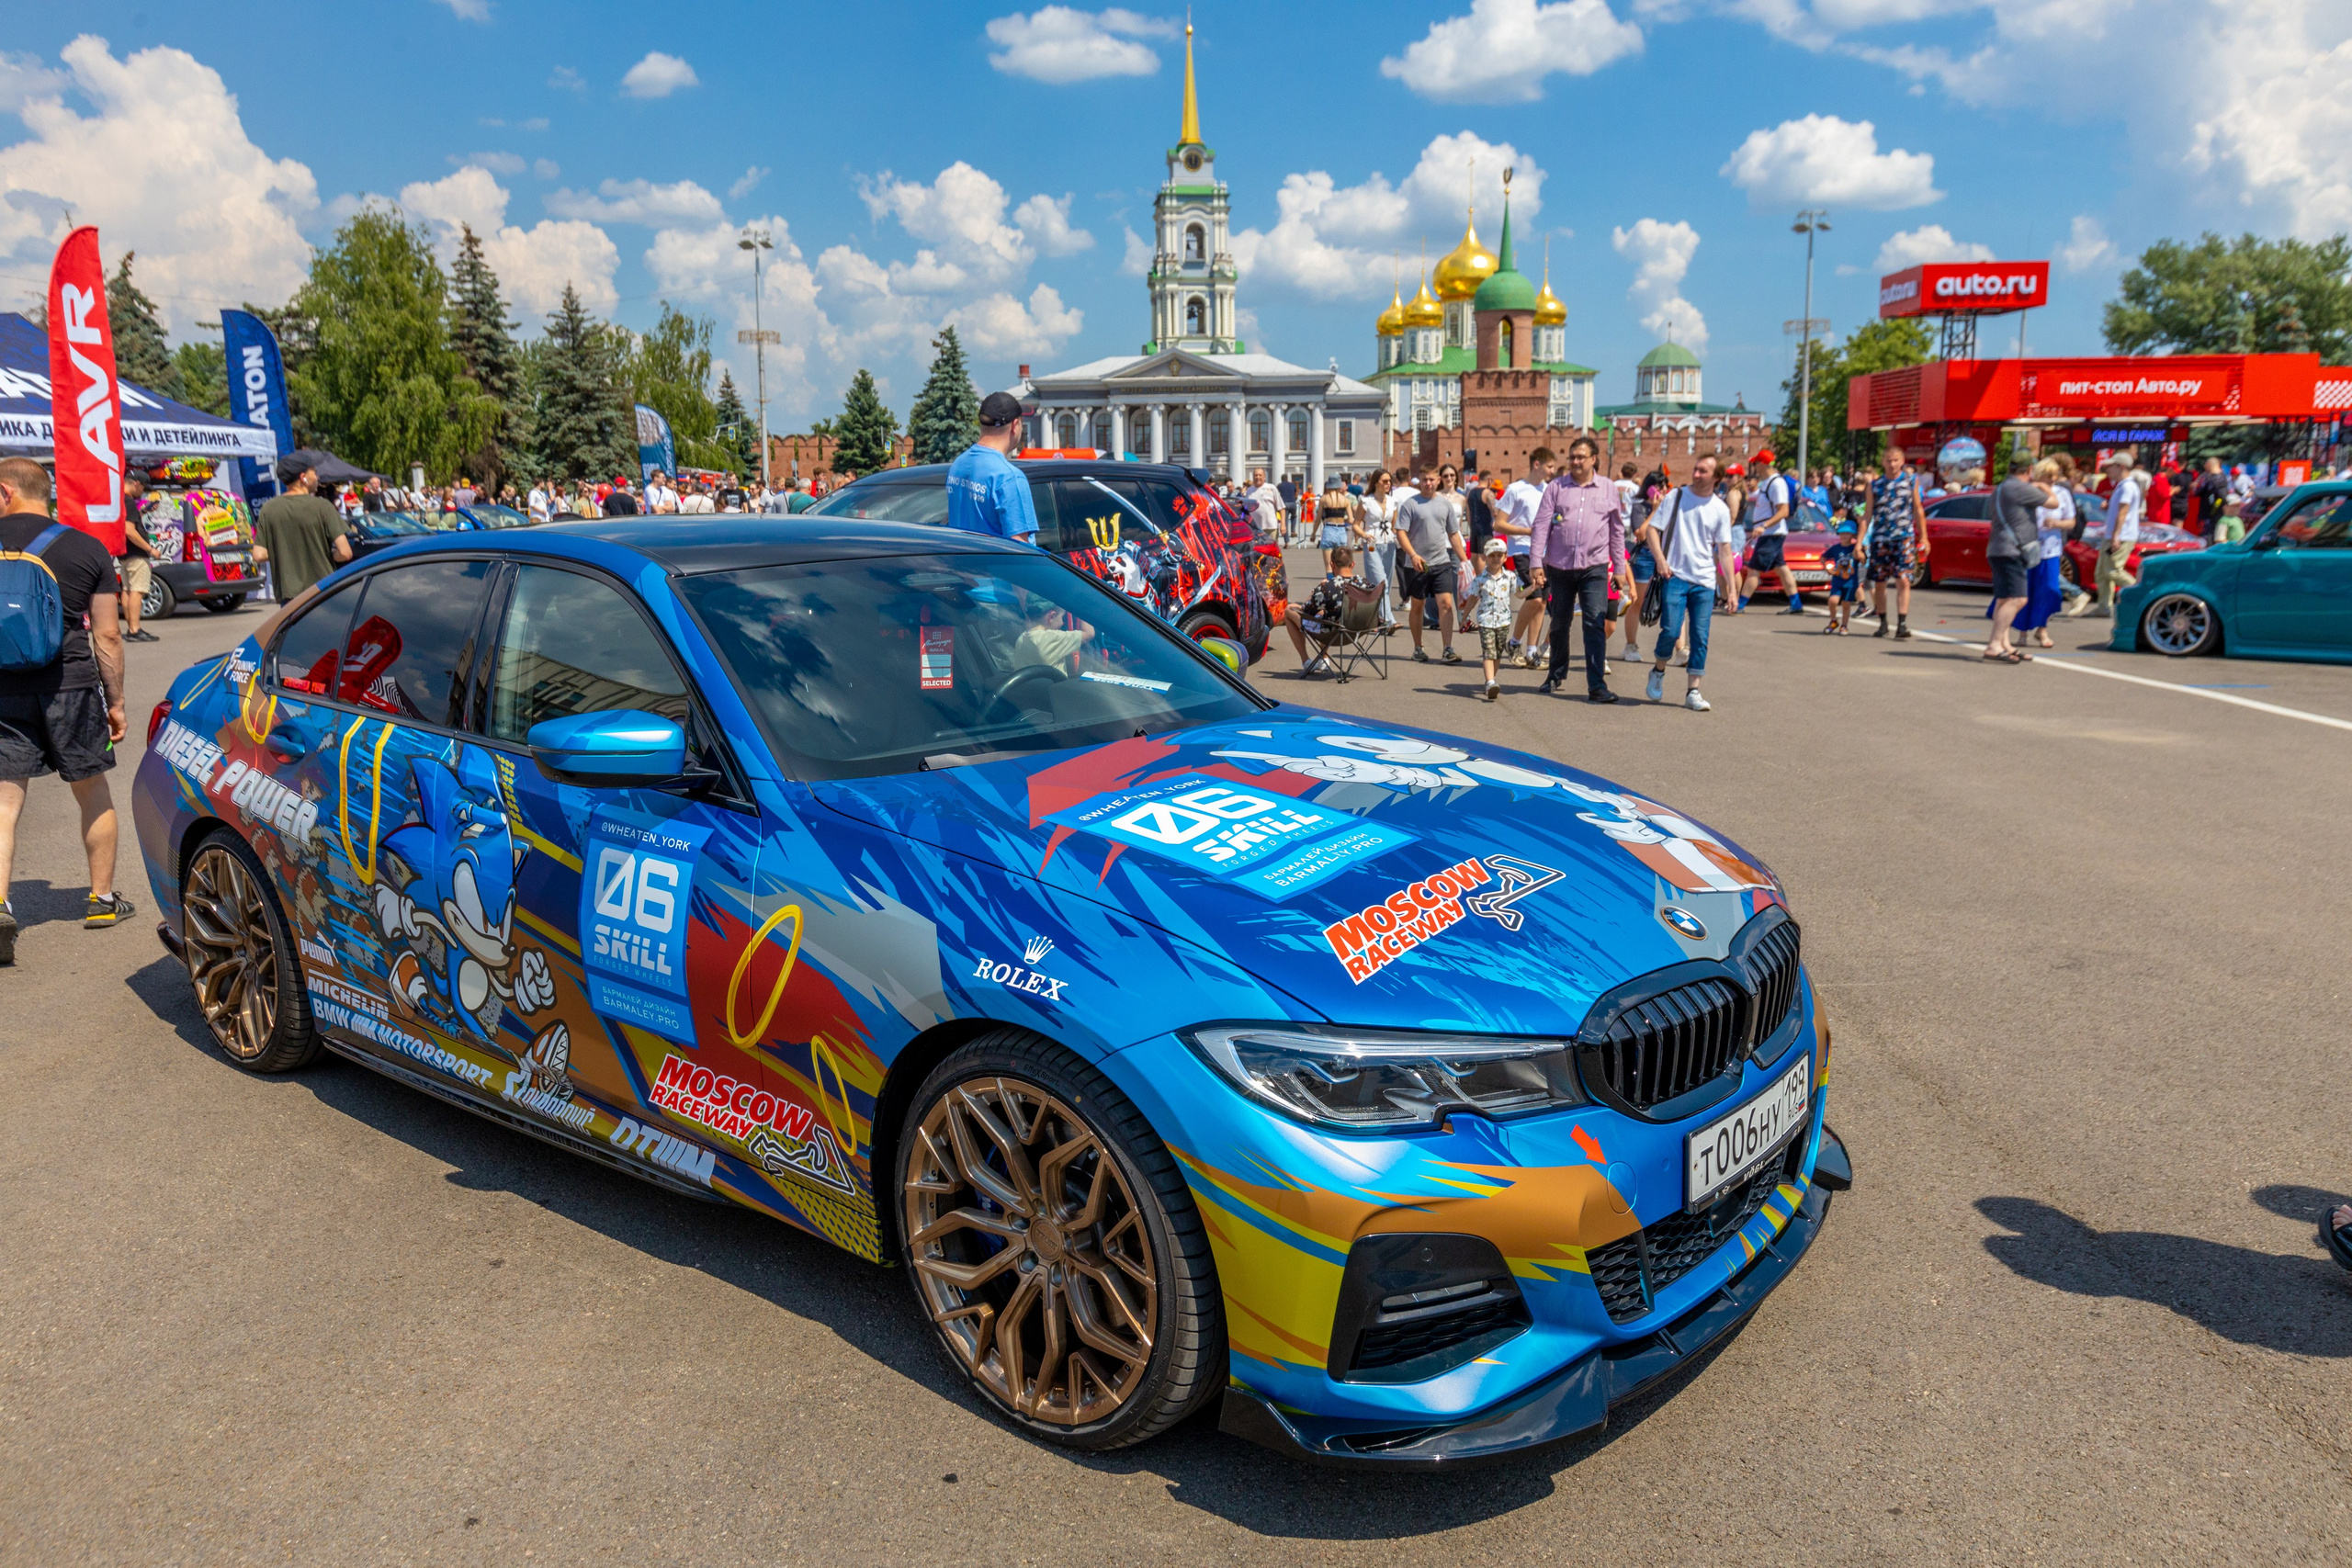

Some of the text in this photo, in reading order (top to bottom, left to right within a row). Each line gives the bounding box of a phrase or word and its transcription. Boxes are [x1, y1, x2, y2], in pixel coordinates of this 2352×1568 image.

[1935, 273, 2037, 296] auto.ru
[61, 282, 121, 523] LAVR
[2060, 377, 2202, 396] пит-стоп Авто.ру
[242, 345, 275, 482] LEATON
[154, 427, 242, 447] ДЕТЕЙЛИНГА
[230, 671, 251, 684] FORCE
[235, 659, 256, 672] TUNING
[154, 718, 318, 846] DIESEL POWER
[1079, 779, 1206, 821] @WHEATEN_YORK
[602, 822, 691, 852] @WHEATEN_YORK
[1110, 787, 1279, 845] 06
[1193, 808, 1324, 863] SKILL
[1222, 819, 1334, 867] FORGED WHEELS
[1263, 833, 1368, 880] БАРМАЛЕЙ ДИЗАЙН
[1274, 837, 1384, 887] BARMALEY.PRO
[594, 847, 679, 934] 06
[1323, 857, 1492, 964] MOSCOW
[300, 938, 334, 967] PUMA
[594, 923, 672, 976] SKILL
[1342, 897, 1466, 985] RACEWAY
[594, 955, 673, 987] FORGED WHEELS
[973, 958, 1069, 1001] ROLEX
[308, 976, 390, 1021] MICHELIN
[603, 986, 675, 1017] БАРМАЛЕЙ ДИЗАЙН
[604, 996, 680, 1030] BARMALEY.PRO
[312, 997, 350, 1029] BMW
[376, 1023, 493, 1090] MOTORSPORT
[657, 1054, 813, 1140] MOSCOW
[1784, 1064, 1805, 1110] 199
[649, 1083, 754, 1141] RACEWAY
[1787, 1102, 1798, 1122] RUS
